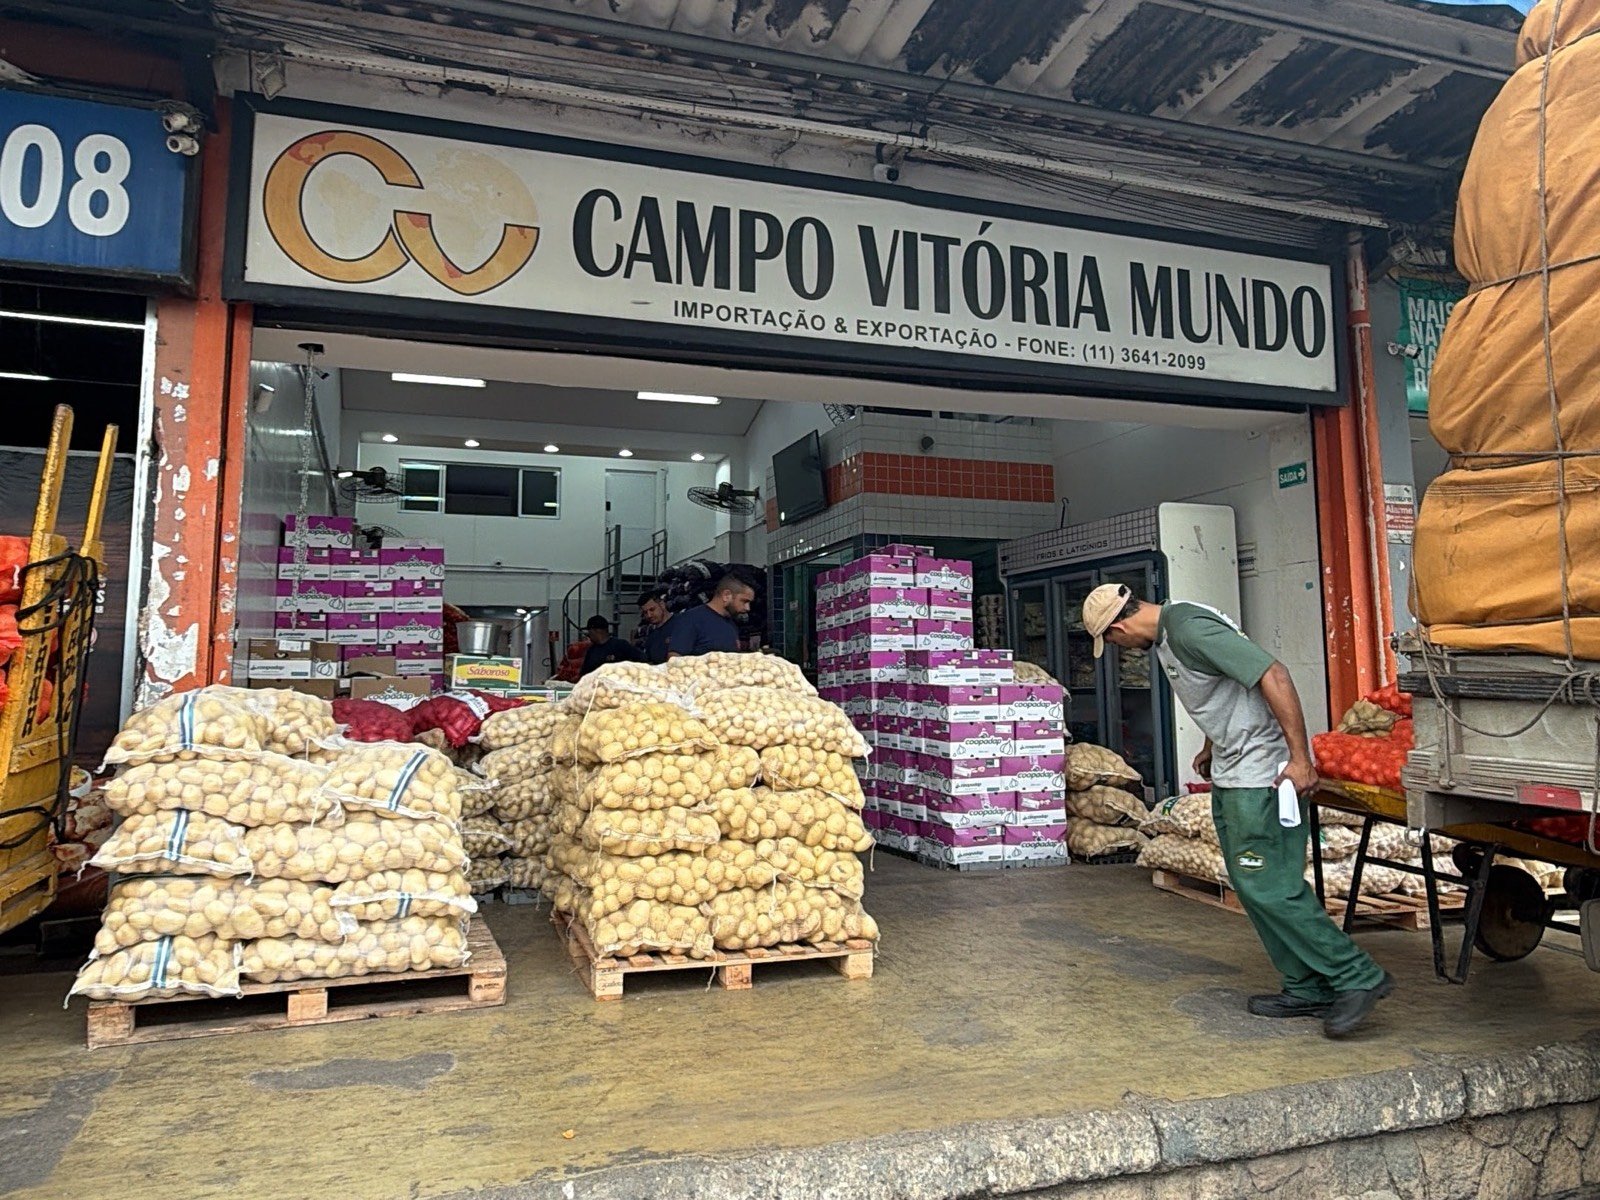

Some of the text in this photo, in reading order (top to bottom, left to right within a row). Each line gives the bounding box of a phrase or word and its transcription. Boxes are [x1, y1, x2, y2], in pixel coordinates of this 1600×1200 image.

[1, 123, 132, 237] 08
[572, 188, 1326, 358] CAMPO VITÓRIA MUNDO
[673, 300, 826, 332] IMPORTAÇÃO
[833, 317, 848, 334] &
[856, 319, 998, 350] EXPORTAÇÃO
[1017, 336, 1076, 358] FONE:
[1082, 343, 1115, 364] (11)
[1121, 347, 1206, 371] 3641-2099
[1409, 320, 1446, 347] NAT
[1386, 505, 1413, 514] Alarme
[1036, 551, 1057, 561] FRIOS
[467, 666, 510, 676] Saboroso
[1014, 701, 1051, 709] coopadap
[965, 738, 1002, 746] coopadap
[1021, 841, 1058, 849] coopadap
